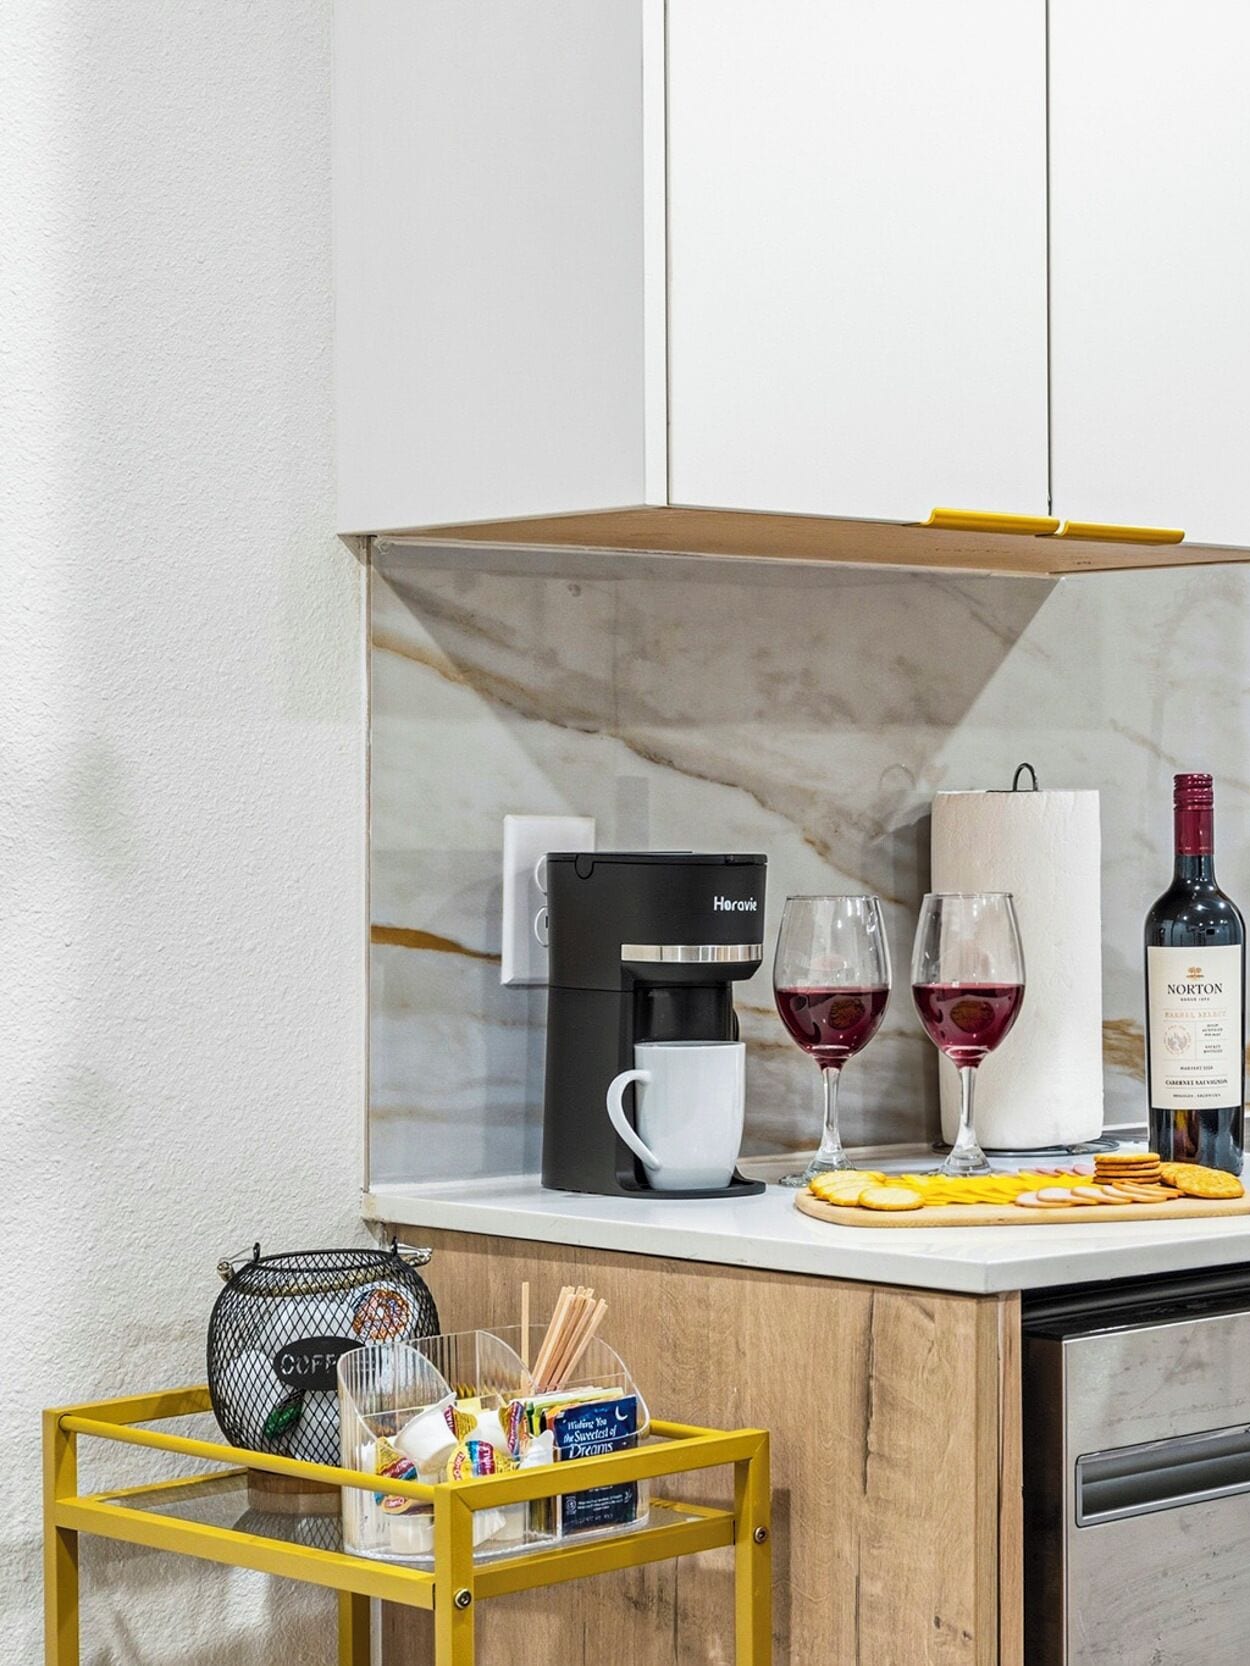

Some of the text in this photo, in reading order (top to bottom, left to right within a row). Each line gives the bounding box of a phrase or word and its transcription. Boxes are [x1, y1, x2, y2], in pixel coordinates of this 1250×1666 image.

[714, 897, 757, 911] Horavie
[1167, 983, 1223, 995] NORTON
[281, 1353, 338, 1375] COFF
[567, 1416, 608, 1431] Wishing You
[563, 1424, 618, 1444] the Sweetest of
[569, 1443, 613, 1458] Dreams
